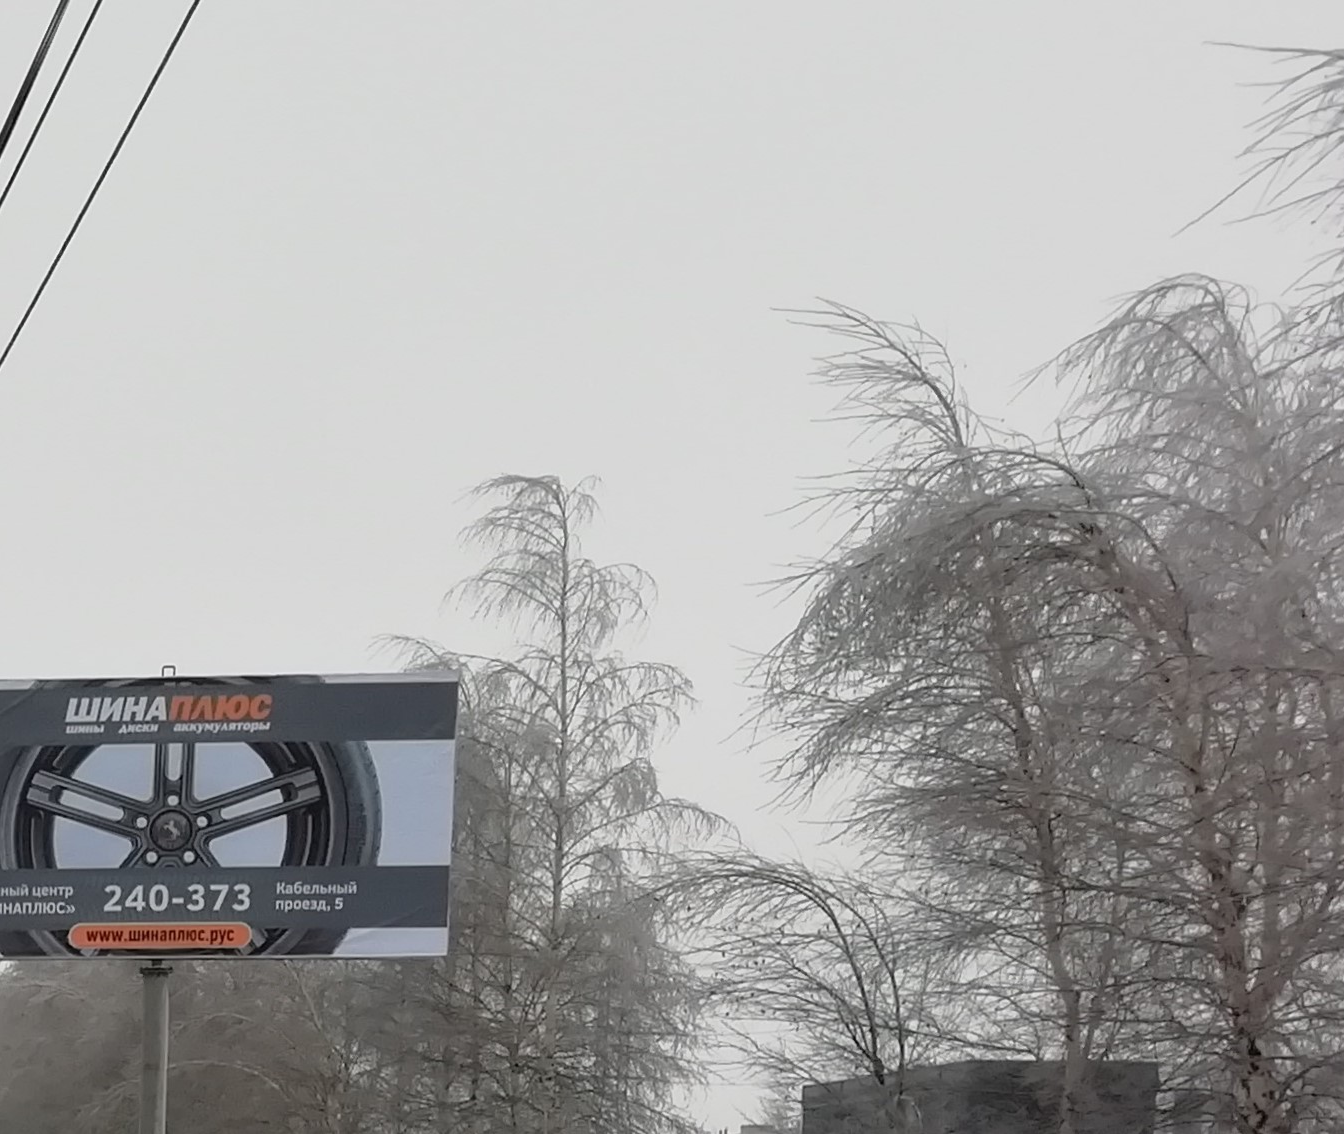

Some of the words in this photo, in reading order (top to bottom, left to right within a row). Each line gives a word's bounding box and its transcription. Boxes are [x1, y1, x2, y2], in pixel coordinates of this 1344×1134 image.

[65, 694, 273, 723] ШИНАПЛЮС
[65, 724, 105, 735] шины
[118, 723, 159, 735] диски
[173, 721, 272, 734] аккумуляторы
[31, 886, 74, 900] центр
[276, 881, 358, 895] Кабельный
[102, 883, 252, 912] 240-373
[275, 898, 331, 912] проезд,
[334, 897, 344, 910] 5
[86, 928, 235, 946] www.шинаплюс.рус
